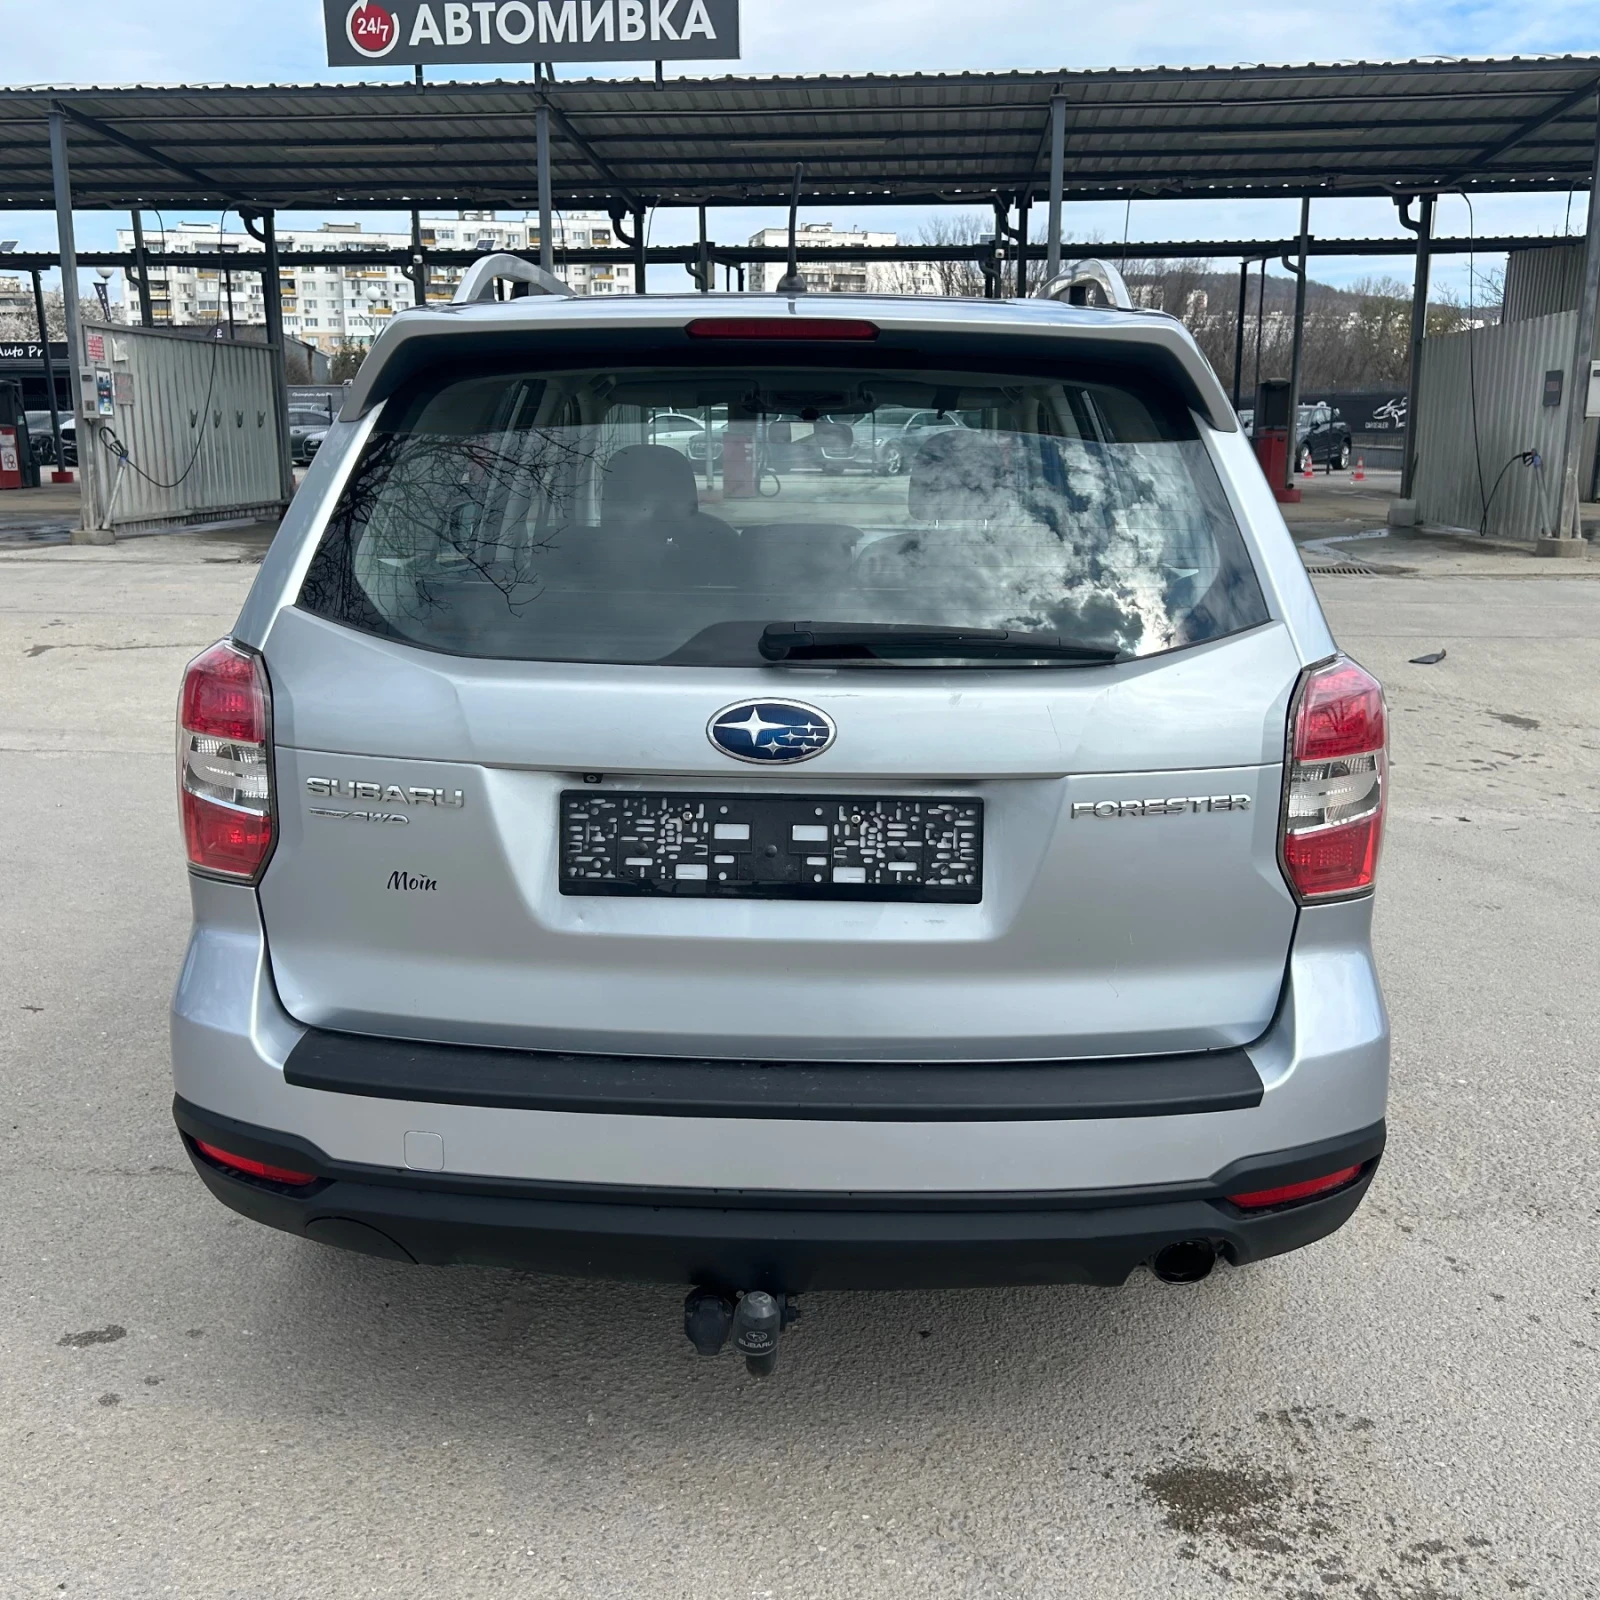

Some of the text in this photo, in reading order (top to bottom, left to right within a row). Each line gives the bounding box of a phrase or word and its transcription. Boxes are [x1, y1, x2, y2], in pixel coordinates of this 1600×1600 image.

[357, 16, 389, 42] 24/7
[408, 0, 717, 46] АВТОМИВКА
[28, 345, 44, 358] Pr
[306, 775, 465, 808] SUBARU
[346, 811, 410, 825] AWD
[1070, 793, 1252, 820] FORESTER
[738, 1337, 774, 1349] SUBARU
